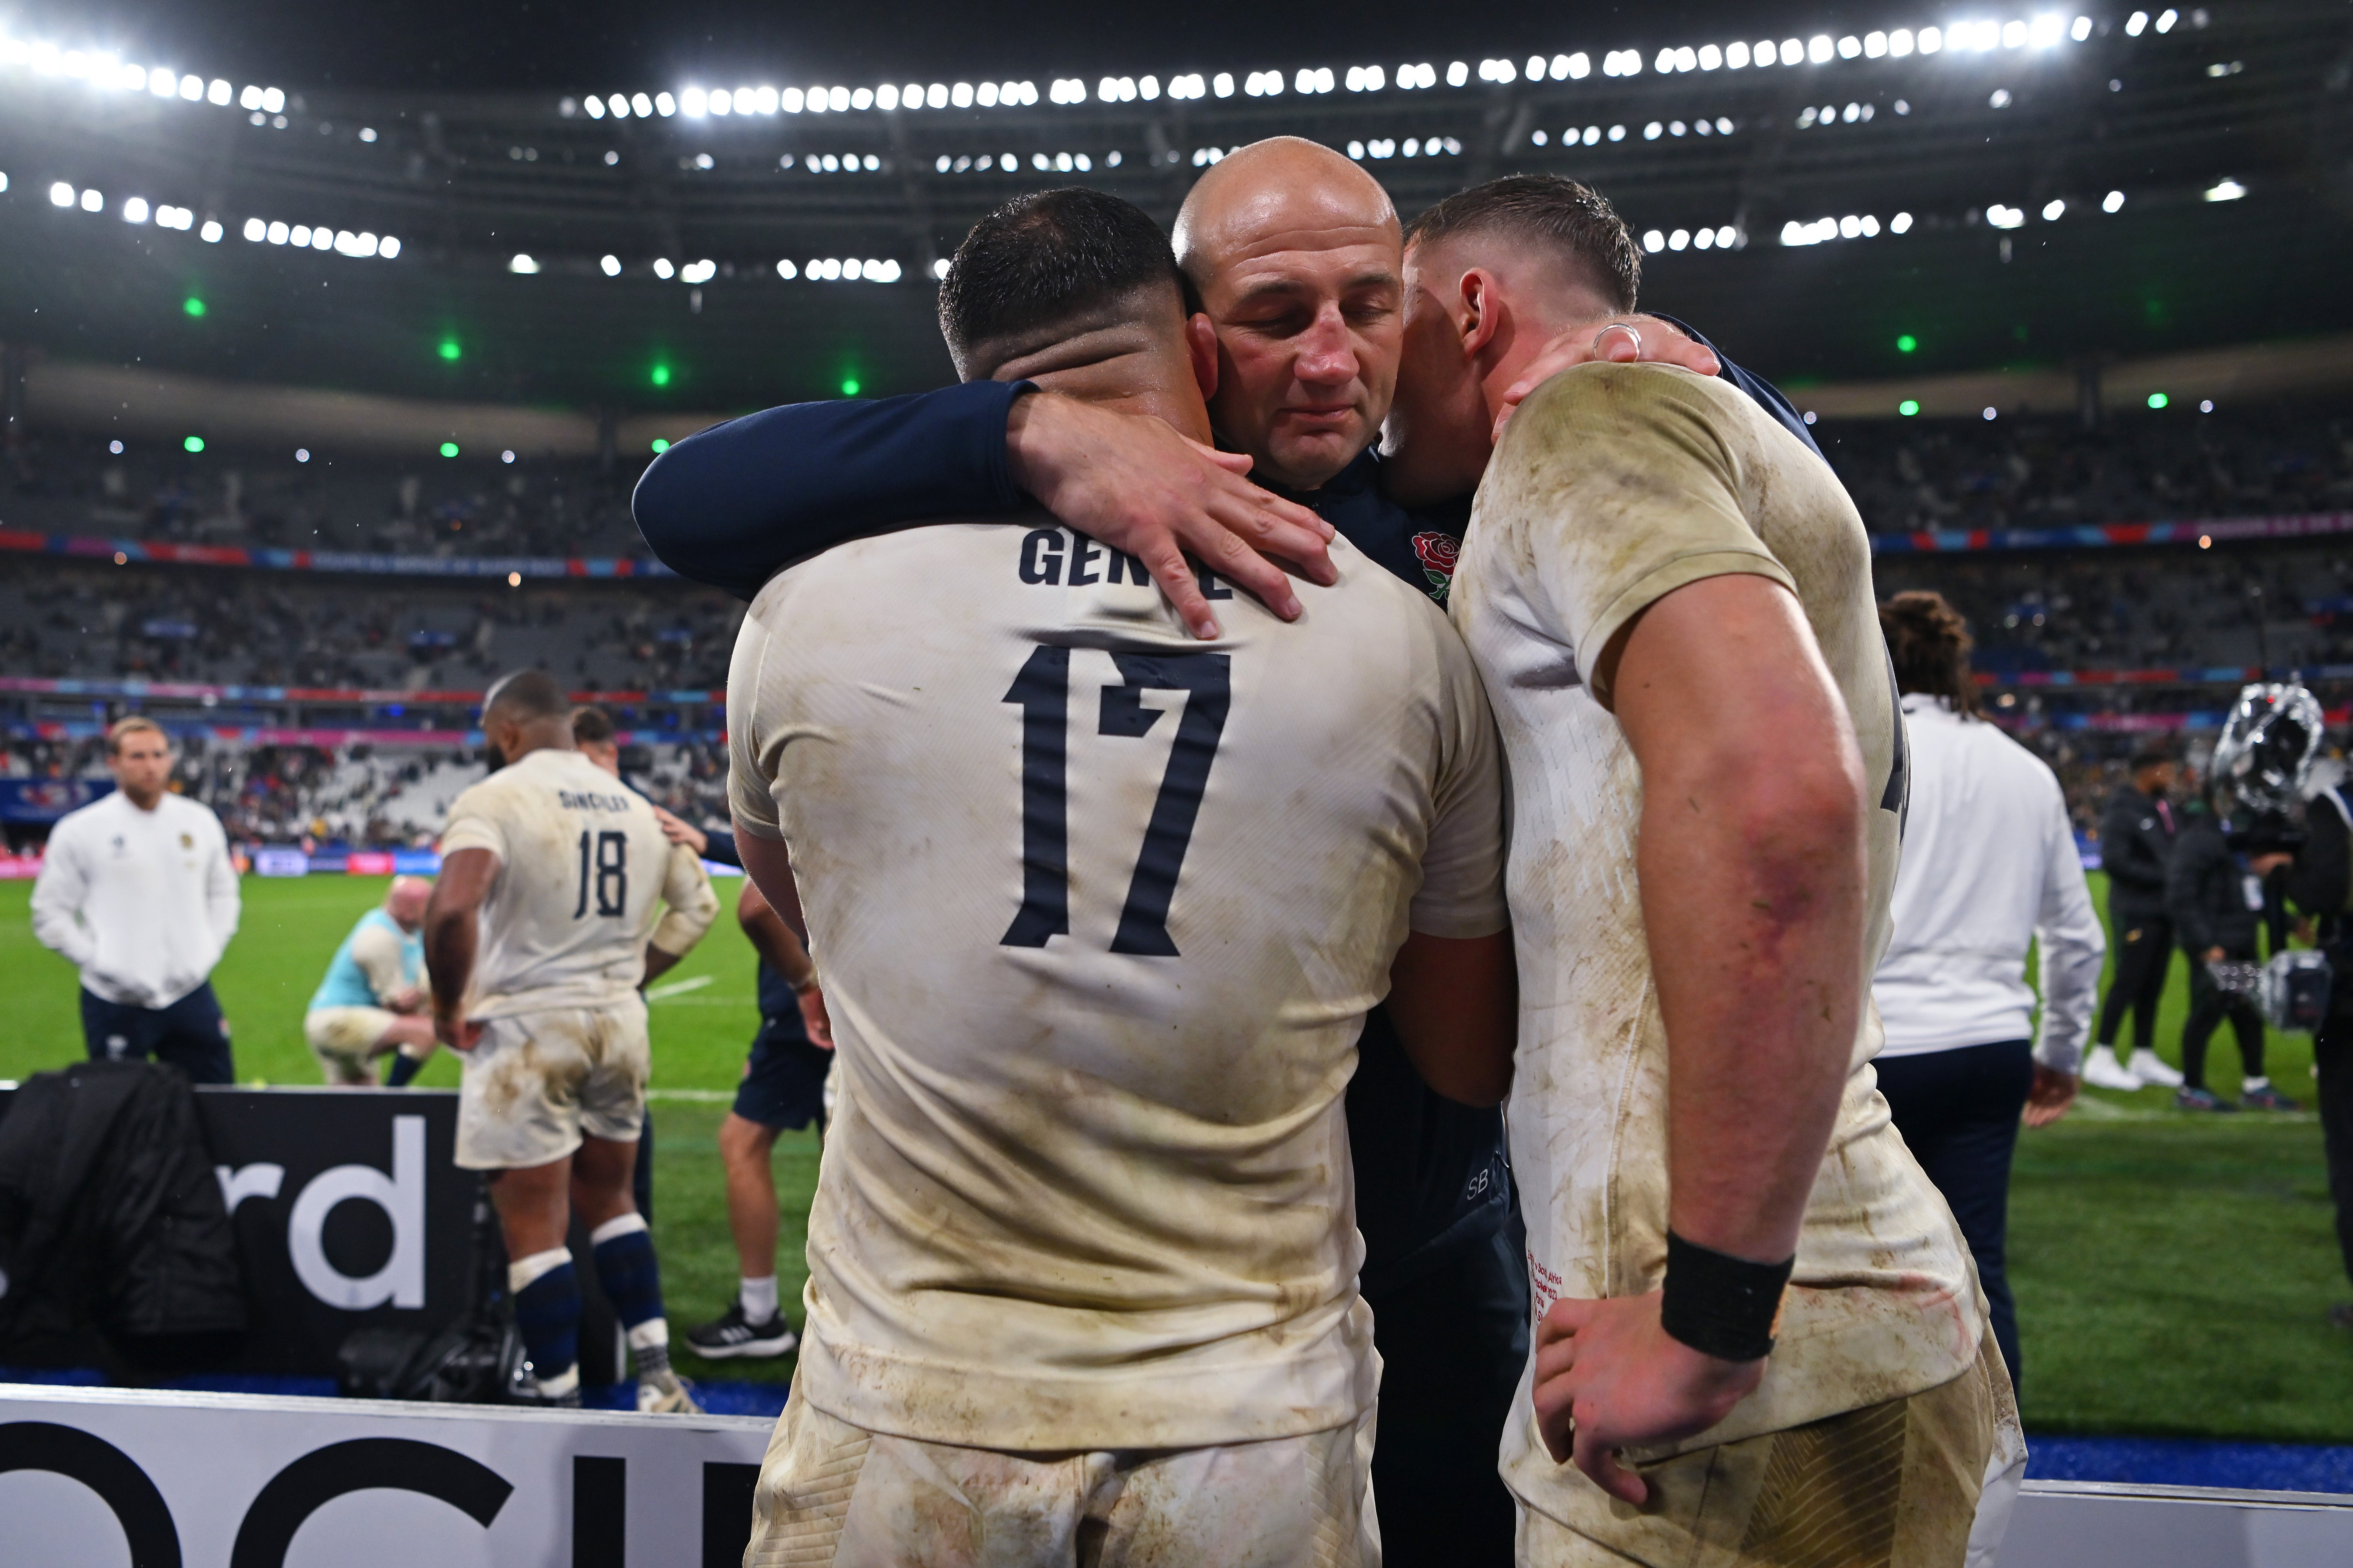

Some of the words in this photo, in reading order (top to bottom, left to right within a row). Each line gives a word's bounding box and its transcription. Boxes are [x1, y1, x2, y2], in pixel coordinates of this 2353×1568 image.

[1000, 645, 1231, 956] 17
[572, 830, 628, 920] 18
[1467, 1169, 1489, 1200] SB
